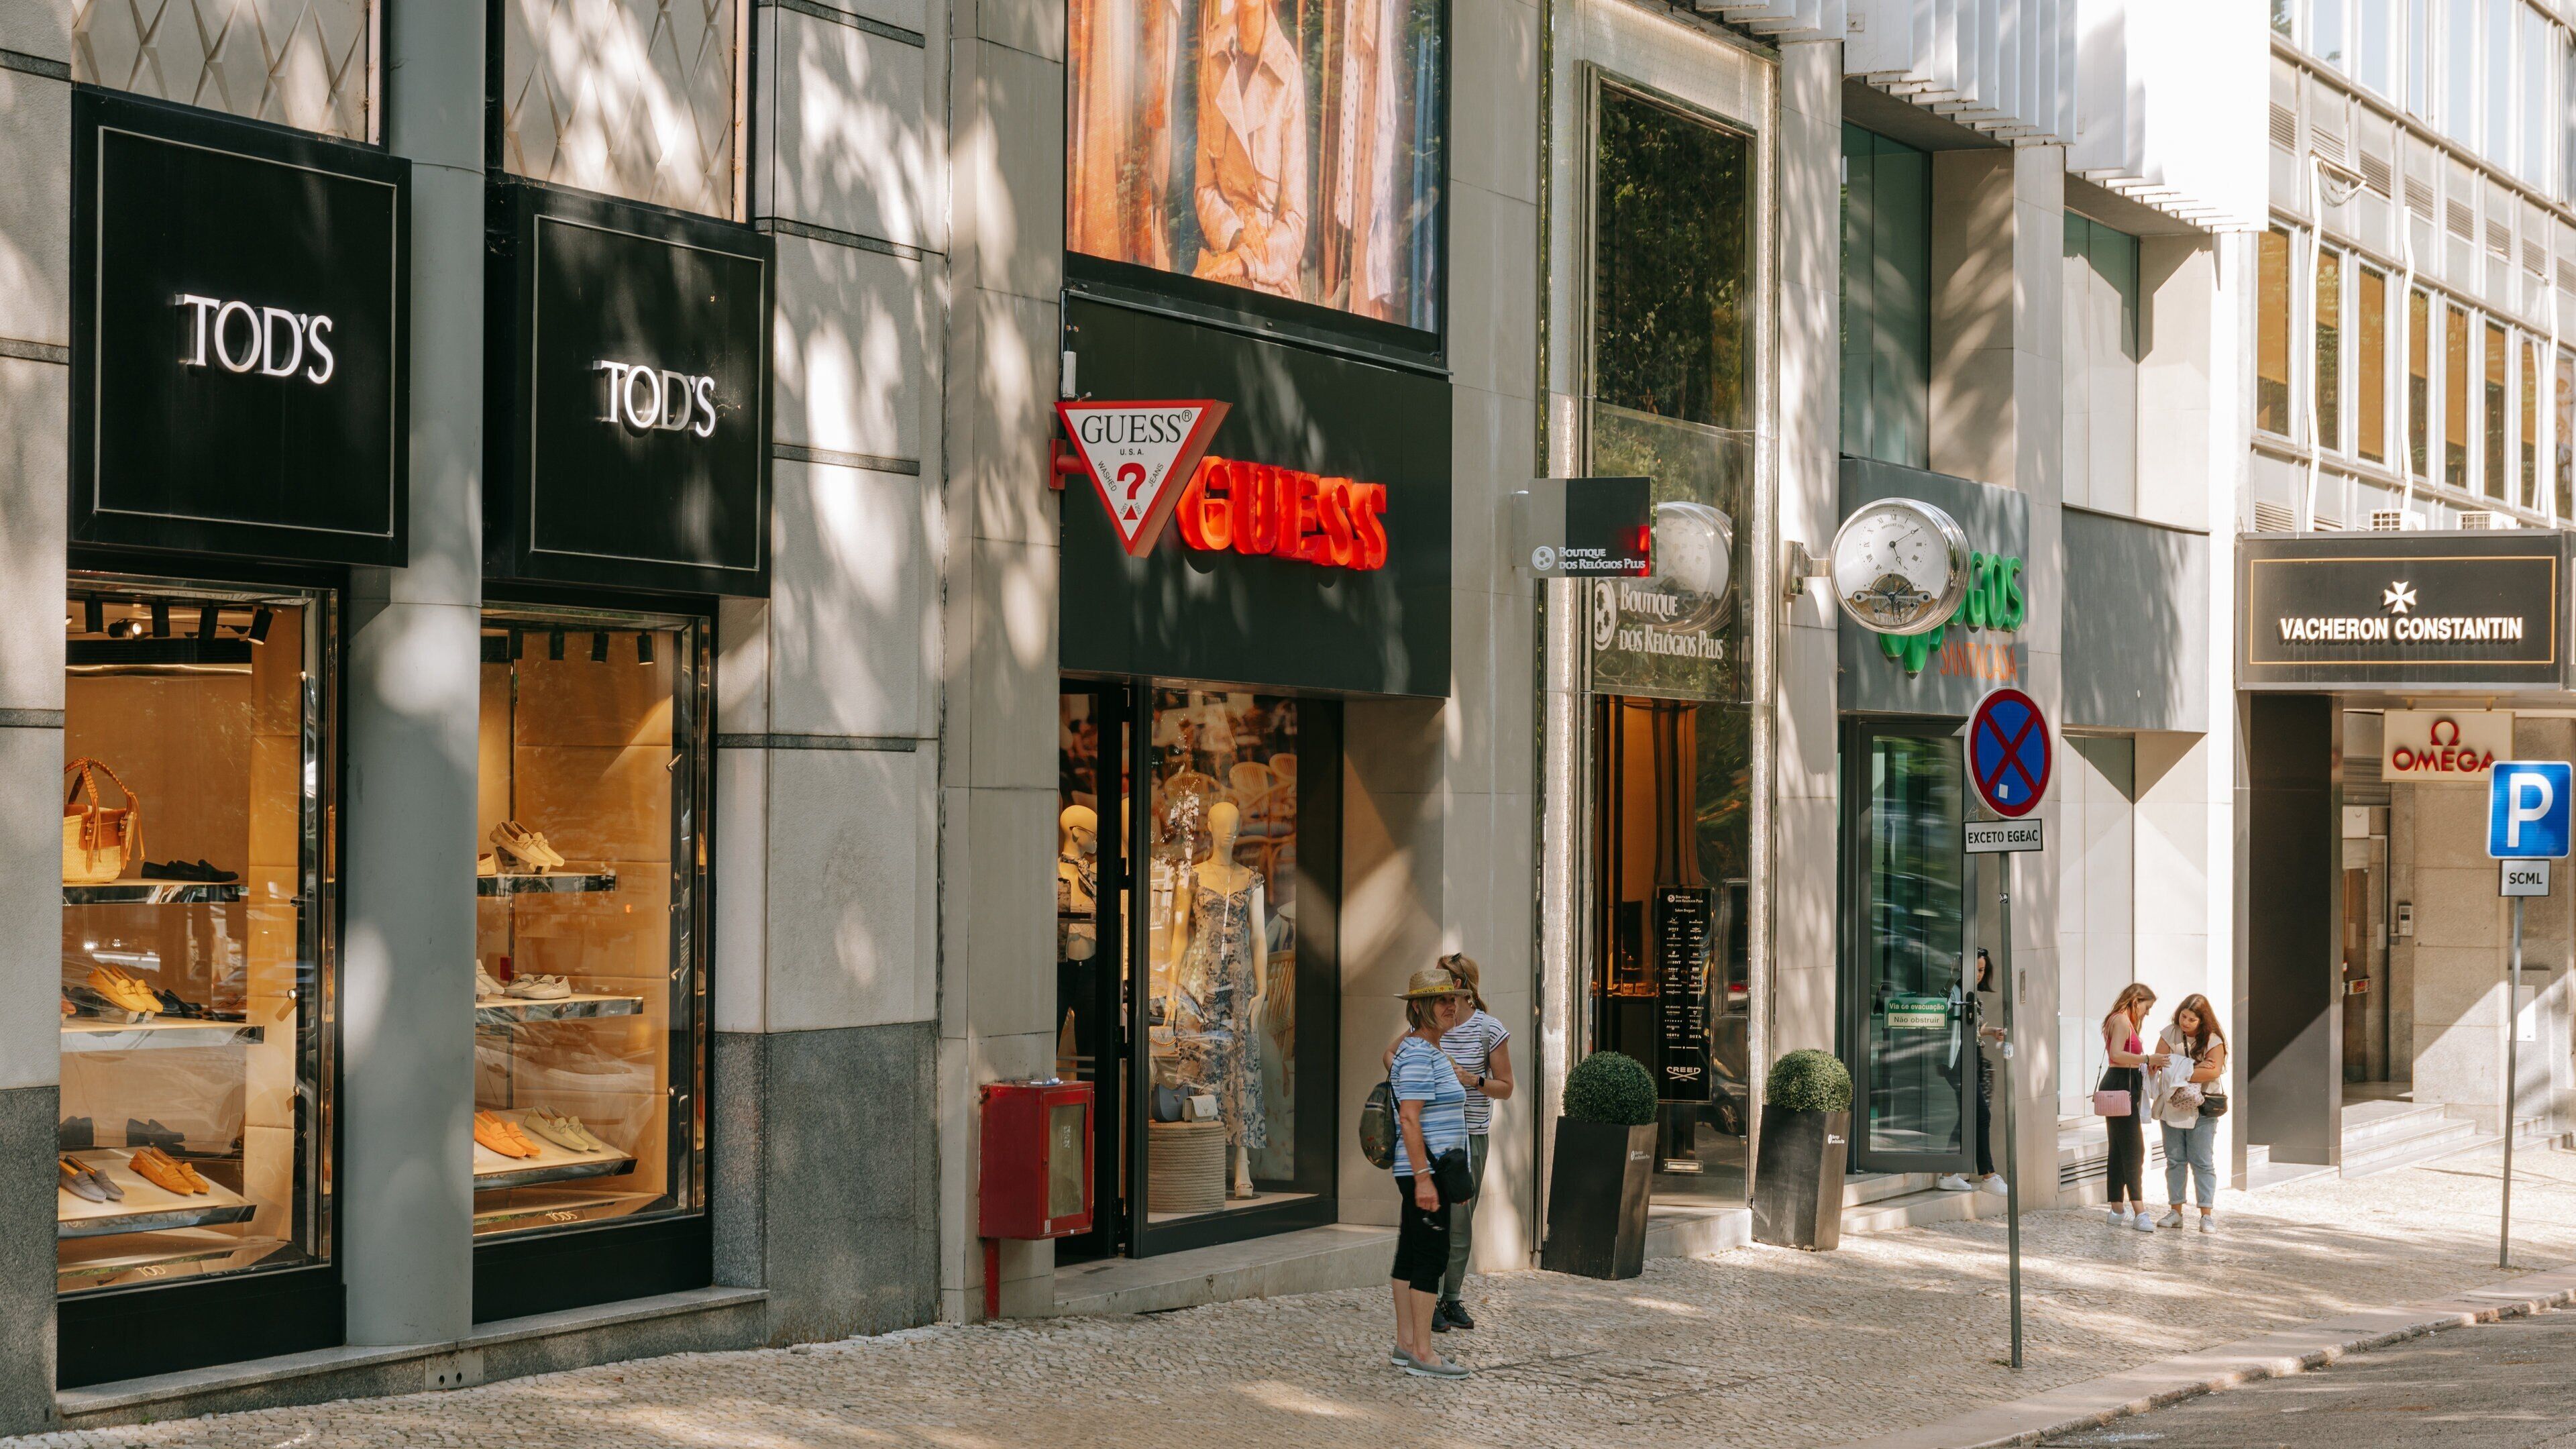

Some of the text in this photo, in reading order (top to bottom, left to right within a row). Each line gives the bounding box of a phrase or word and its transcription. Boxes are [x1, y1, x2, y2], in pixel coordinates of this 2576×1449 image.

[176, 294, 333, 384] TOD'S
[593, 360, 716, 437] TOD'S
[1097, 460, 1118, 492] WASHED
[1148, 463, 1164, 488] JEANS
[1175, 455, 1387, 570] GUESS
[1930, 550, 2025, 652] GOS
[2279, 617, 2523, 640] VACHERON CONSTANTIN
[2392, 749, 2495, 772] OMEGA
[2508, 773, 2553, 847] P
[1968, 829, 2038, 844] EXCETO EGEAC
[2509, 872, 2543, 884] SCML
[1911, 1003, 1945, 1012] evacuação
[1666, 1067, 1701, 1077] CREED
